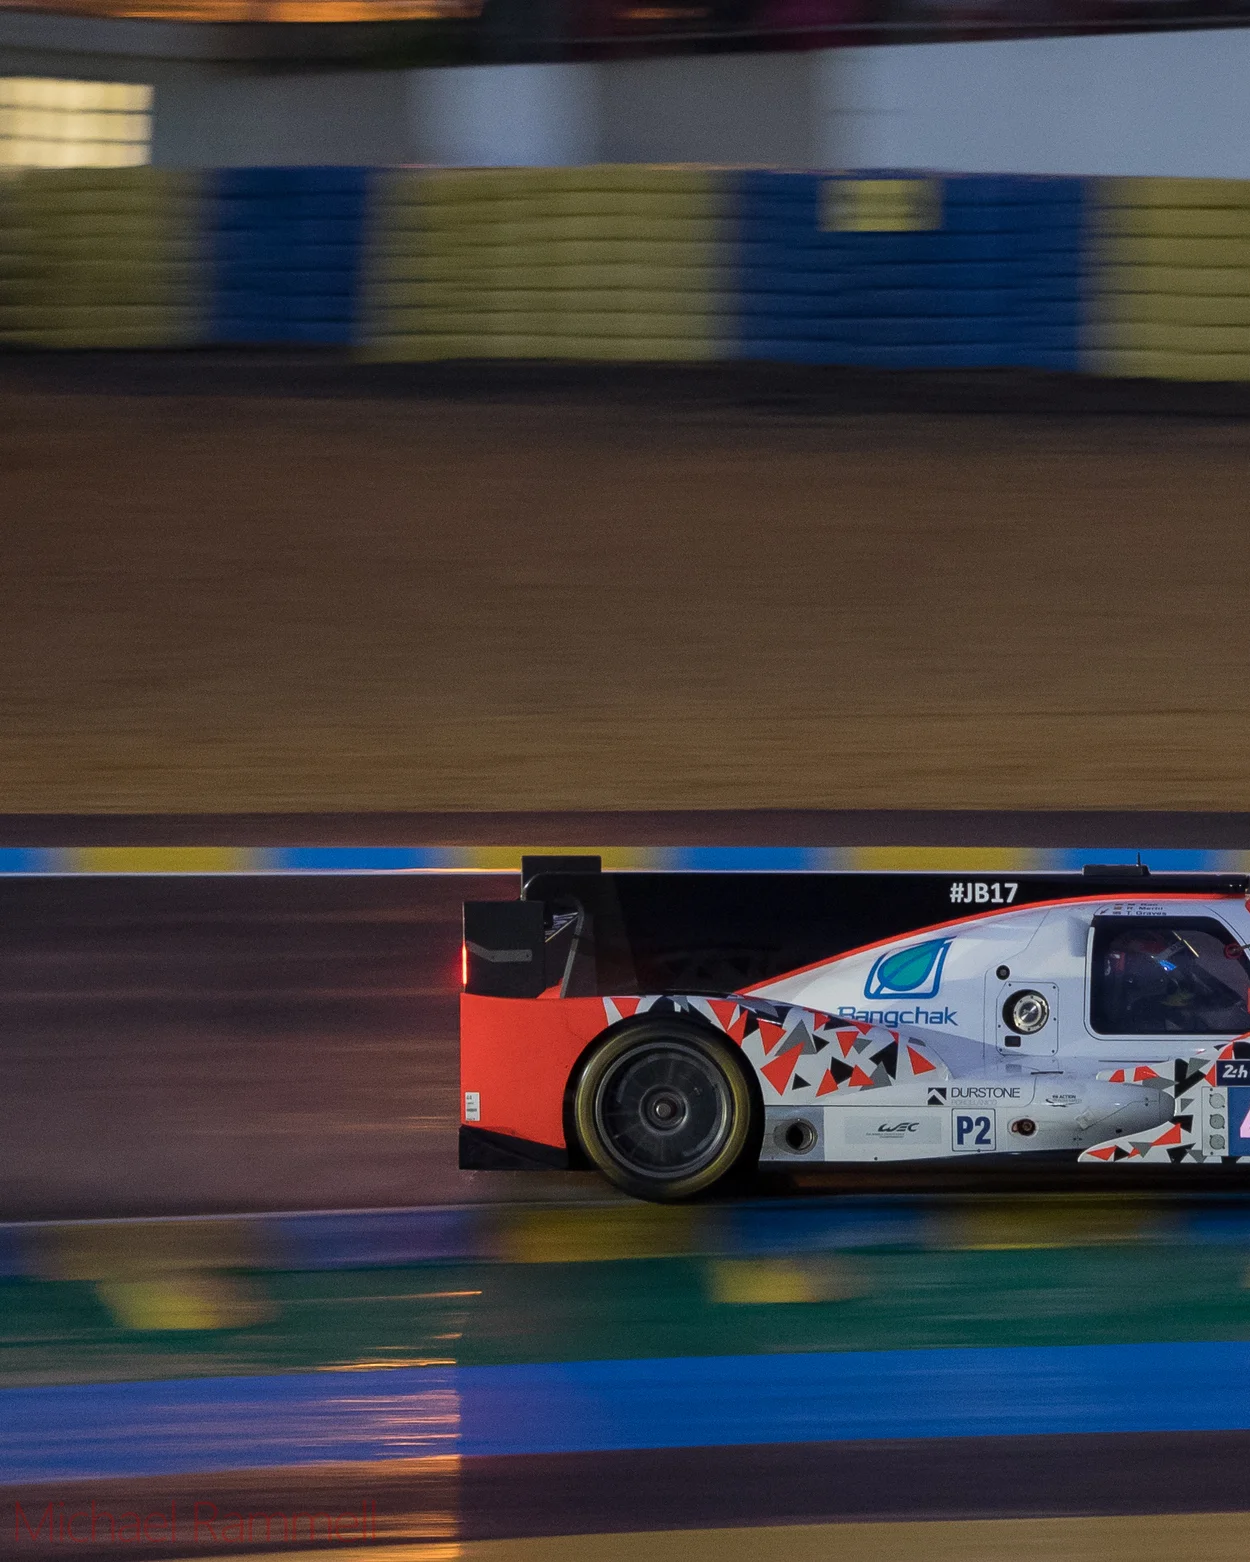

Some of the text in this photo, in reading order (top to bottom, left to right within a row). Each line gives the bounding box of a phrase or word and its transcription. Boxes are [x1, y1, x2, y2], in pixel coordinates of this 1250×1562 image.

[949, 882, 1019, 903] #JB17
[951, 1087, 1021, 1098] DURSTONE
[877, 1122, 920, 1133] WEC
[956, 1115, 992, 1146] P2
